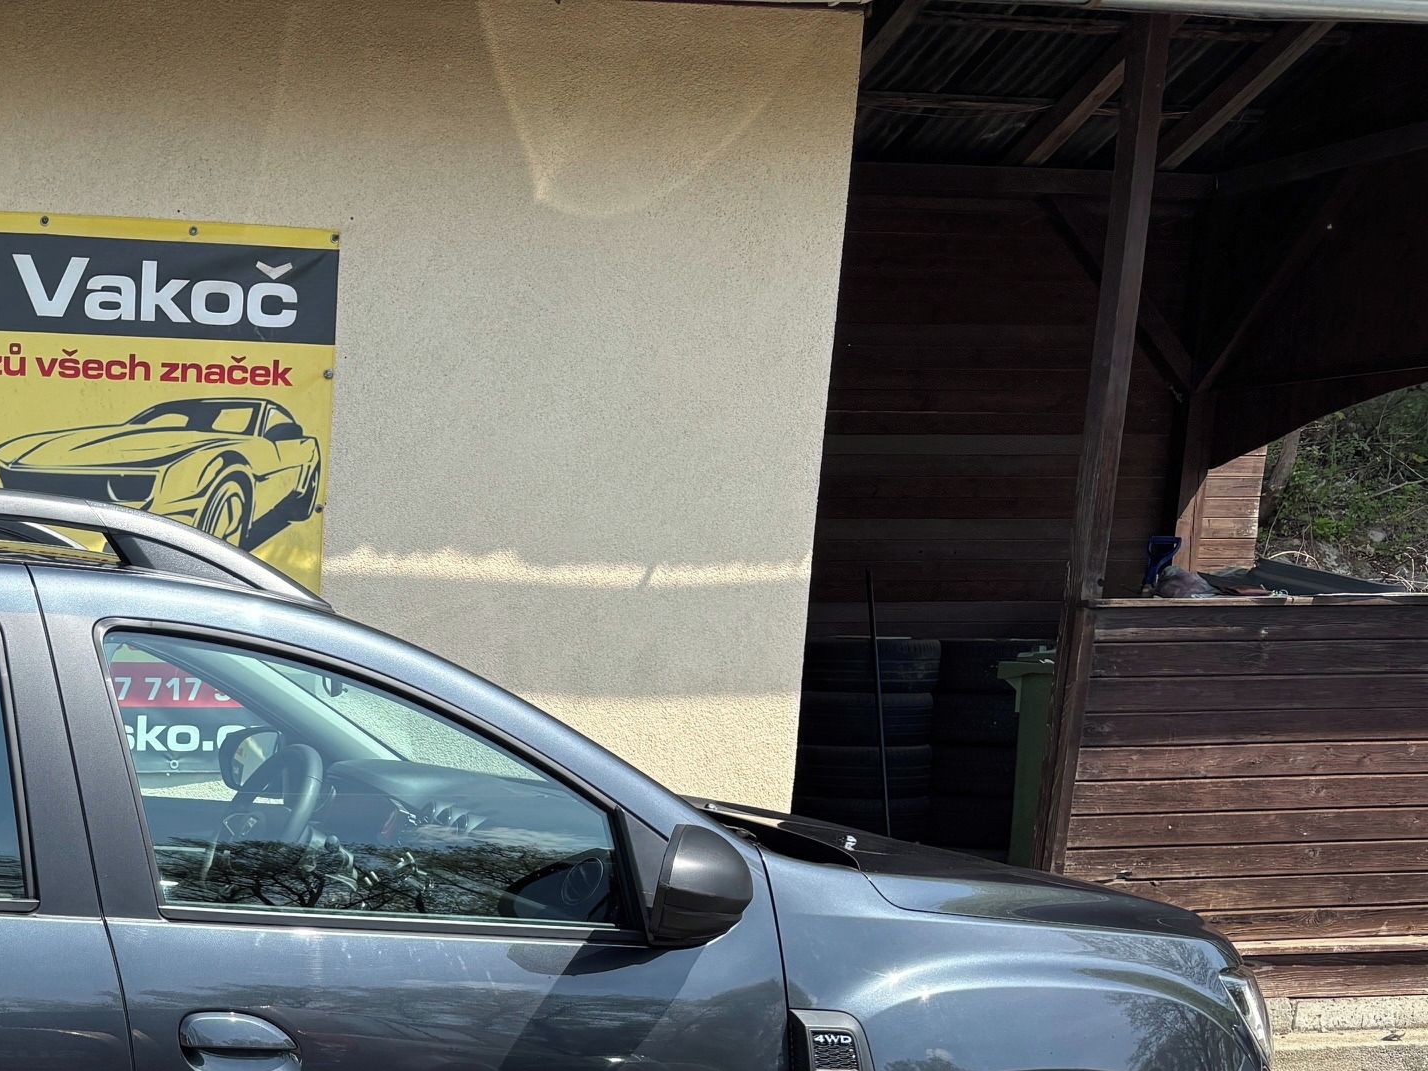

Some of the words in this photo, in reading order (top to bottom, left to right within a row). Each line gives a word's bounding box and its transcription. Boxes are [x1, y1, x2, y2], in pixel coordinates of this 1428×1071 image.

[12, 253, 298, 328] Vakoč
[35, 348, 152, 382] všech
[159, 355, 293, 387] značek
[144, 676, 203, 702] 717
[813, 1034, 852, 1044] 4WD
